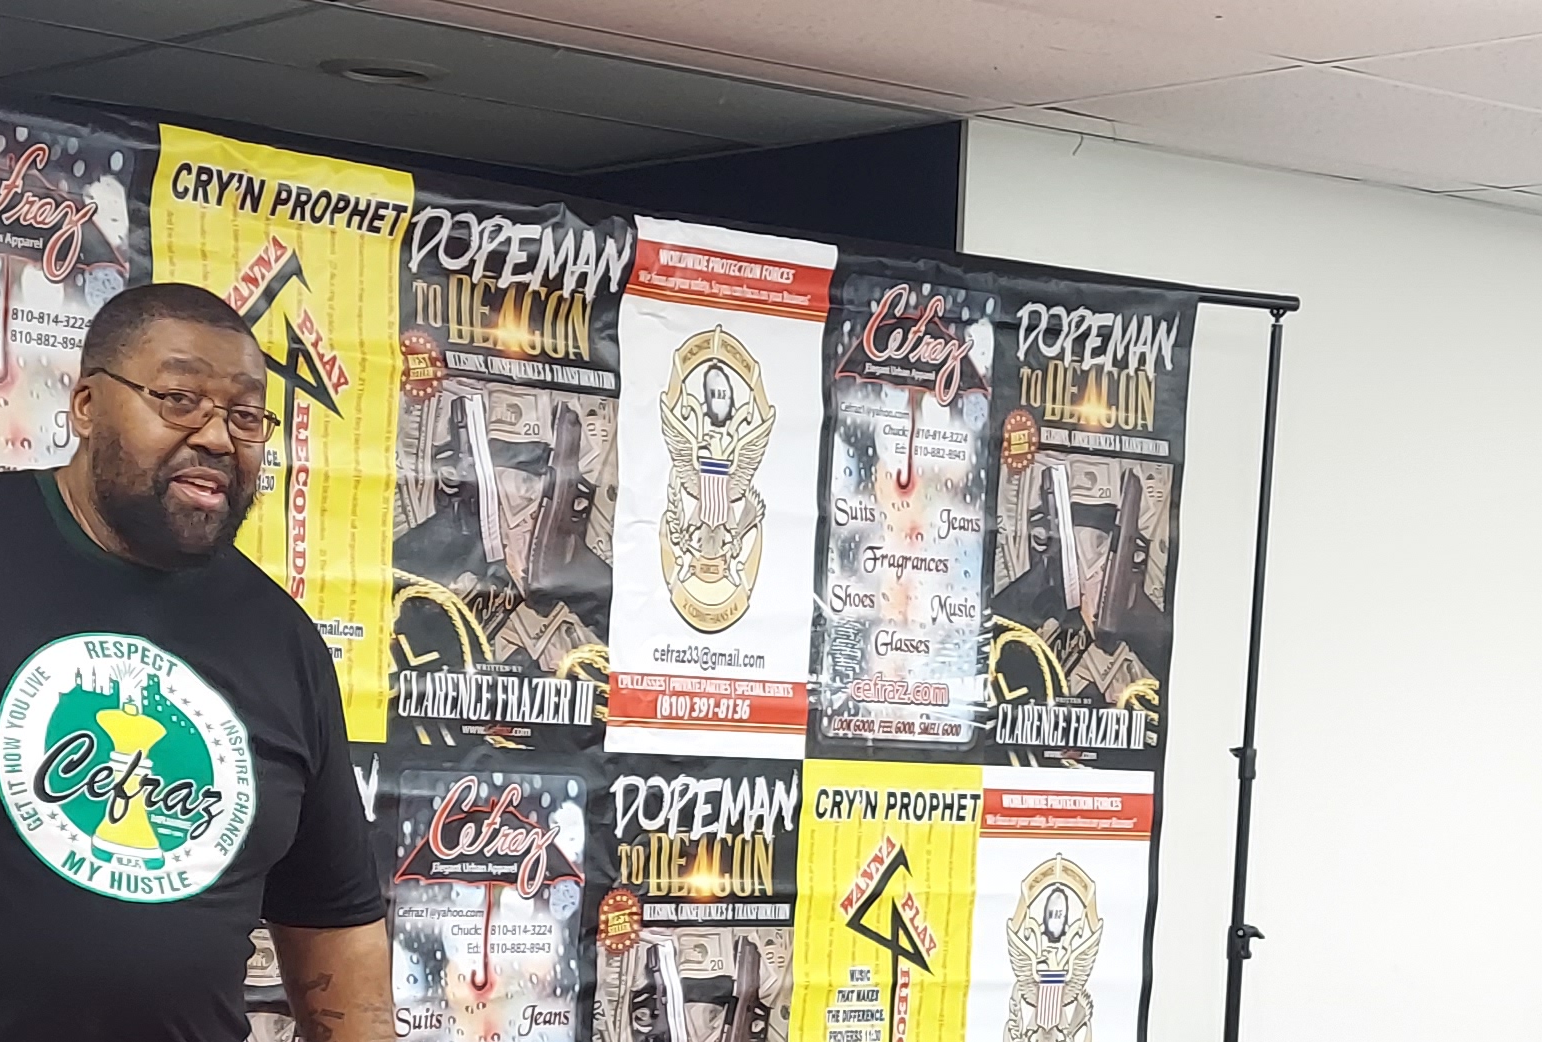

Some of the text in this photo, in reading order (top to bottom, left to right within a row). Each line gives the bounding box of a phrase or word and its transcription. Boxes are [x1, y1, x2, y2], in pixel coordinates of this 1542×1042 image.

[269, 182, 409, 238] PROPHET
[5, 230, 43, 250] Apparel
[409, 205, 635, 304] DOPEMAN
[660, 249, 795, 283] WORLDWIDE PROTECTION FORCES
[412, 274, 592, 361] TO DEACON
[296, 308, 349, 395] PLAY
[1017, 301, 1181, 381] DOPEMAN
[1019, 360, 1157, 432] TO DEACON
[523, 423, 540, 436] 20
[291, 402, 311, 600] RECORDS
[1099, 488, 1111, 498] 20
[834, 498, 981, 539] Suits Jeans
[863, 546, 949, 581] Fragrances
[830, 584, 976, 625] Shoes Music
[83, 640, 178, 678] RESPECT
[653, 647, 765, 670] cefraz33@gmail.com
[875, 630, 930, 656] Glasses
[398, 669, 594, 725] CLARENCE FRAZIER III
[632, 677, 665, 690] CLASSES
[670, 678, 700, 693] PRIVATE
[735, 681, 764, 695] SPECIAL
[850, 672, 949, 706] cefraz.com
[657, 695, 750, 719] (810) 391-8136
[996, 704, 1146, 749] CLARENCE FRAZIER III
[3, 666, 51, 832] GET IT HOW YOU LIVE
[33, 732, 224, 840] Cefraz
[214, 720, 249, 856] INSPIRE CHANGE
[609, 769, 799, 844] DOPEMAN
[815, 789, 878, 820] CRY'N
[884, 791, 981, 822] PROPHET
[61, 850, 193, 895] MY HUSTLE
[618, 833, 774, 897] TO DEACON
[840, 835, 896, 916] WANNA
[490, 924, 553, 936] 810-814-3224
[901, 892, 937, 956] PLAY
[710, 959, 724, 971] 20
[849, 969, 871, 981] MUSIC
[827, 1010, 840, 1022] THE
[837, 990, 879, 1002] THAT MAKES
[394, 1005, 570, 1038] Suits Jeans
